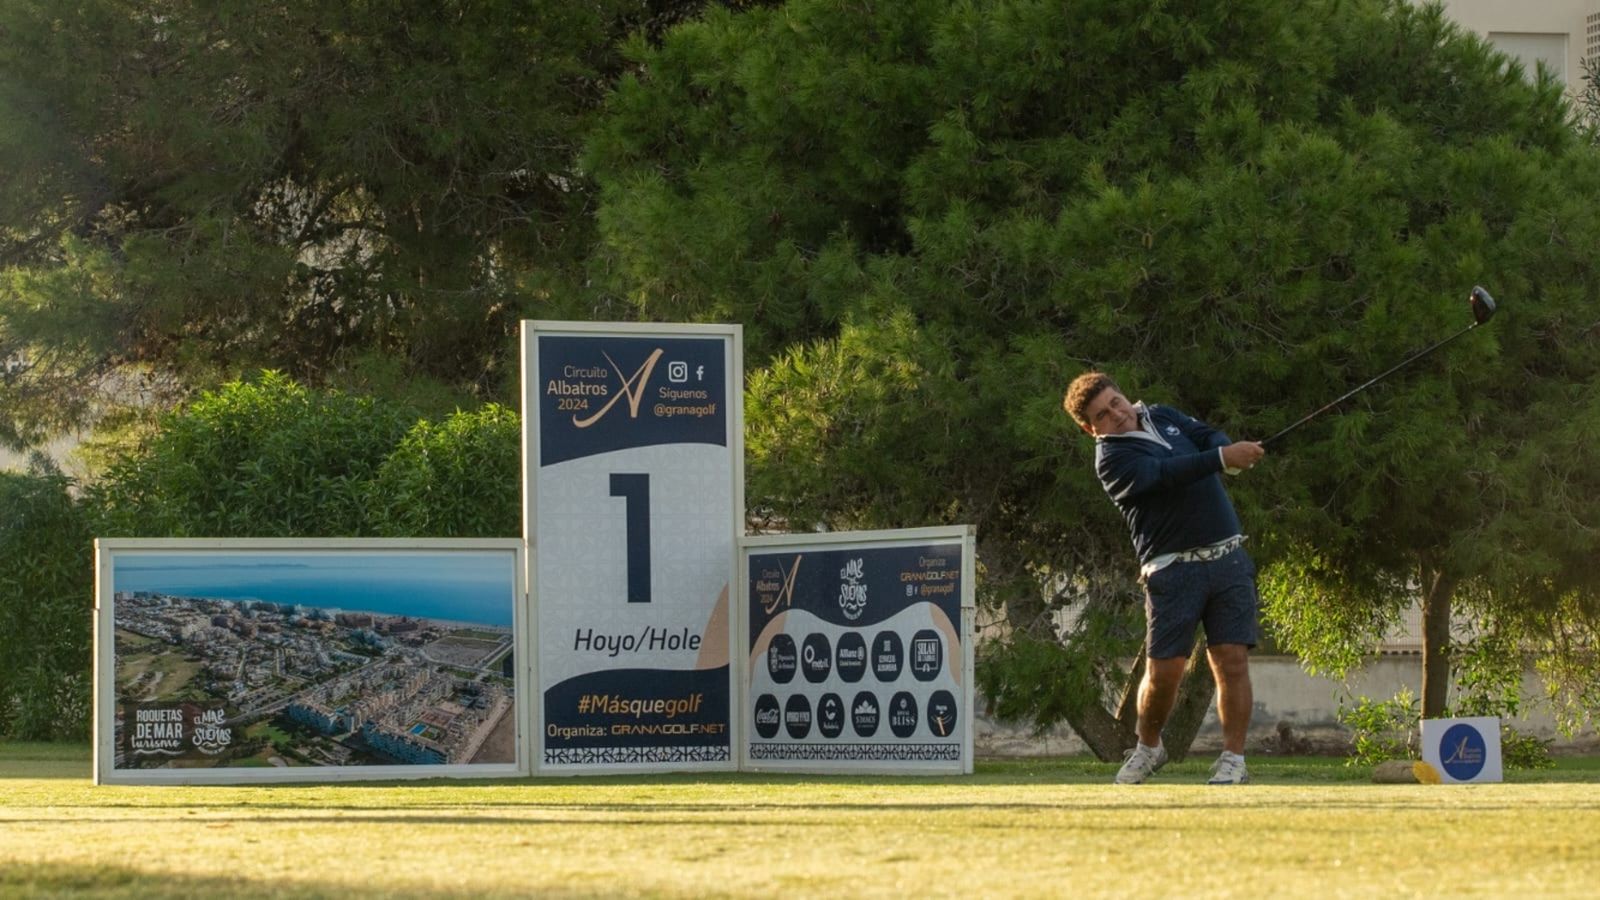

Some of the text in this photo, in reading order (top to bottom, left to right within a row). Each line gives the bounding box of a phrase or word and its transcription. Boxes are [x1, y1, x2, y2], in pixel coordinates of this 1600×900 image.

[564, 365, 608, 379] Circuito
[547, 380, 608, 396] Albatros
[659, 386, 708, 401] Síguenos
[557, 399, 589, 410] 2024
[654, 403, 716, 418] @granagolf
[609, 473, 652, 603] 1
[574, 626, 701, 657] Hoyo/Hole
[578, 694, 703, 718] #Másquegolf
[136, 709, 183, 722] ROQUETAS
[892, 716, 915, 726] BLISS
[137, 723, 183, 738] DE MAR
[547, 724, 725, 740] Organiza: GRANAGOLF.NET
